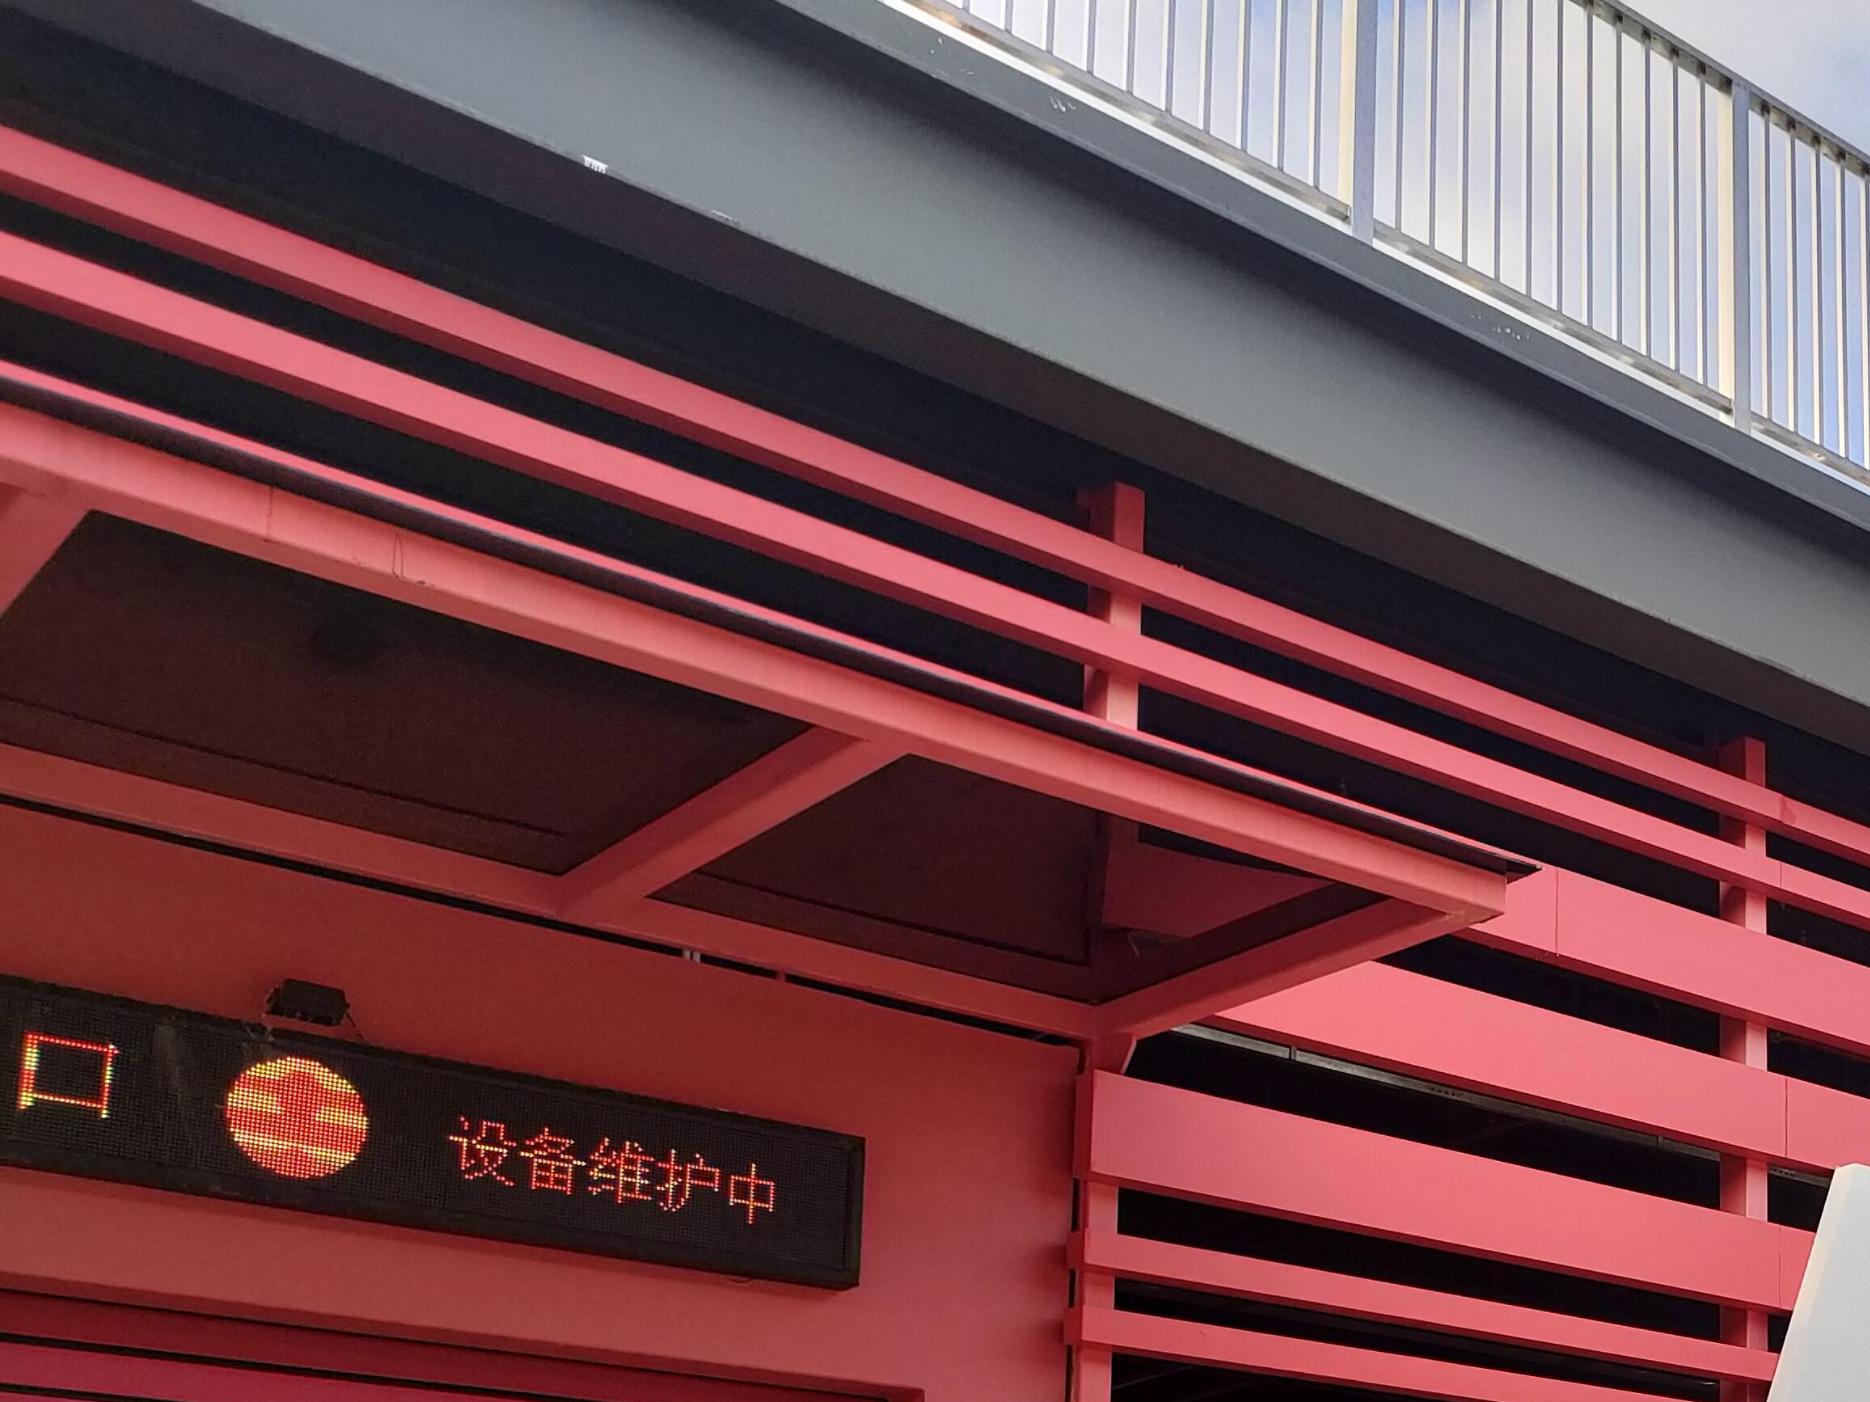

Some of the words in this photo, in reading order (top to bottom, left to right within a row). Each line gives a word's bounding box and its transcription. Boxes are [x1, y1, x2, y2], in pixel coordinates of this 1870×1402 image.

[17, 1031, 120, 1119] 口
[448, 1115, 778, 1225] 设备维护中
